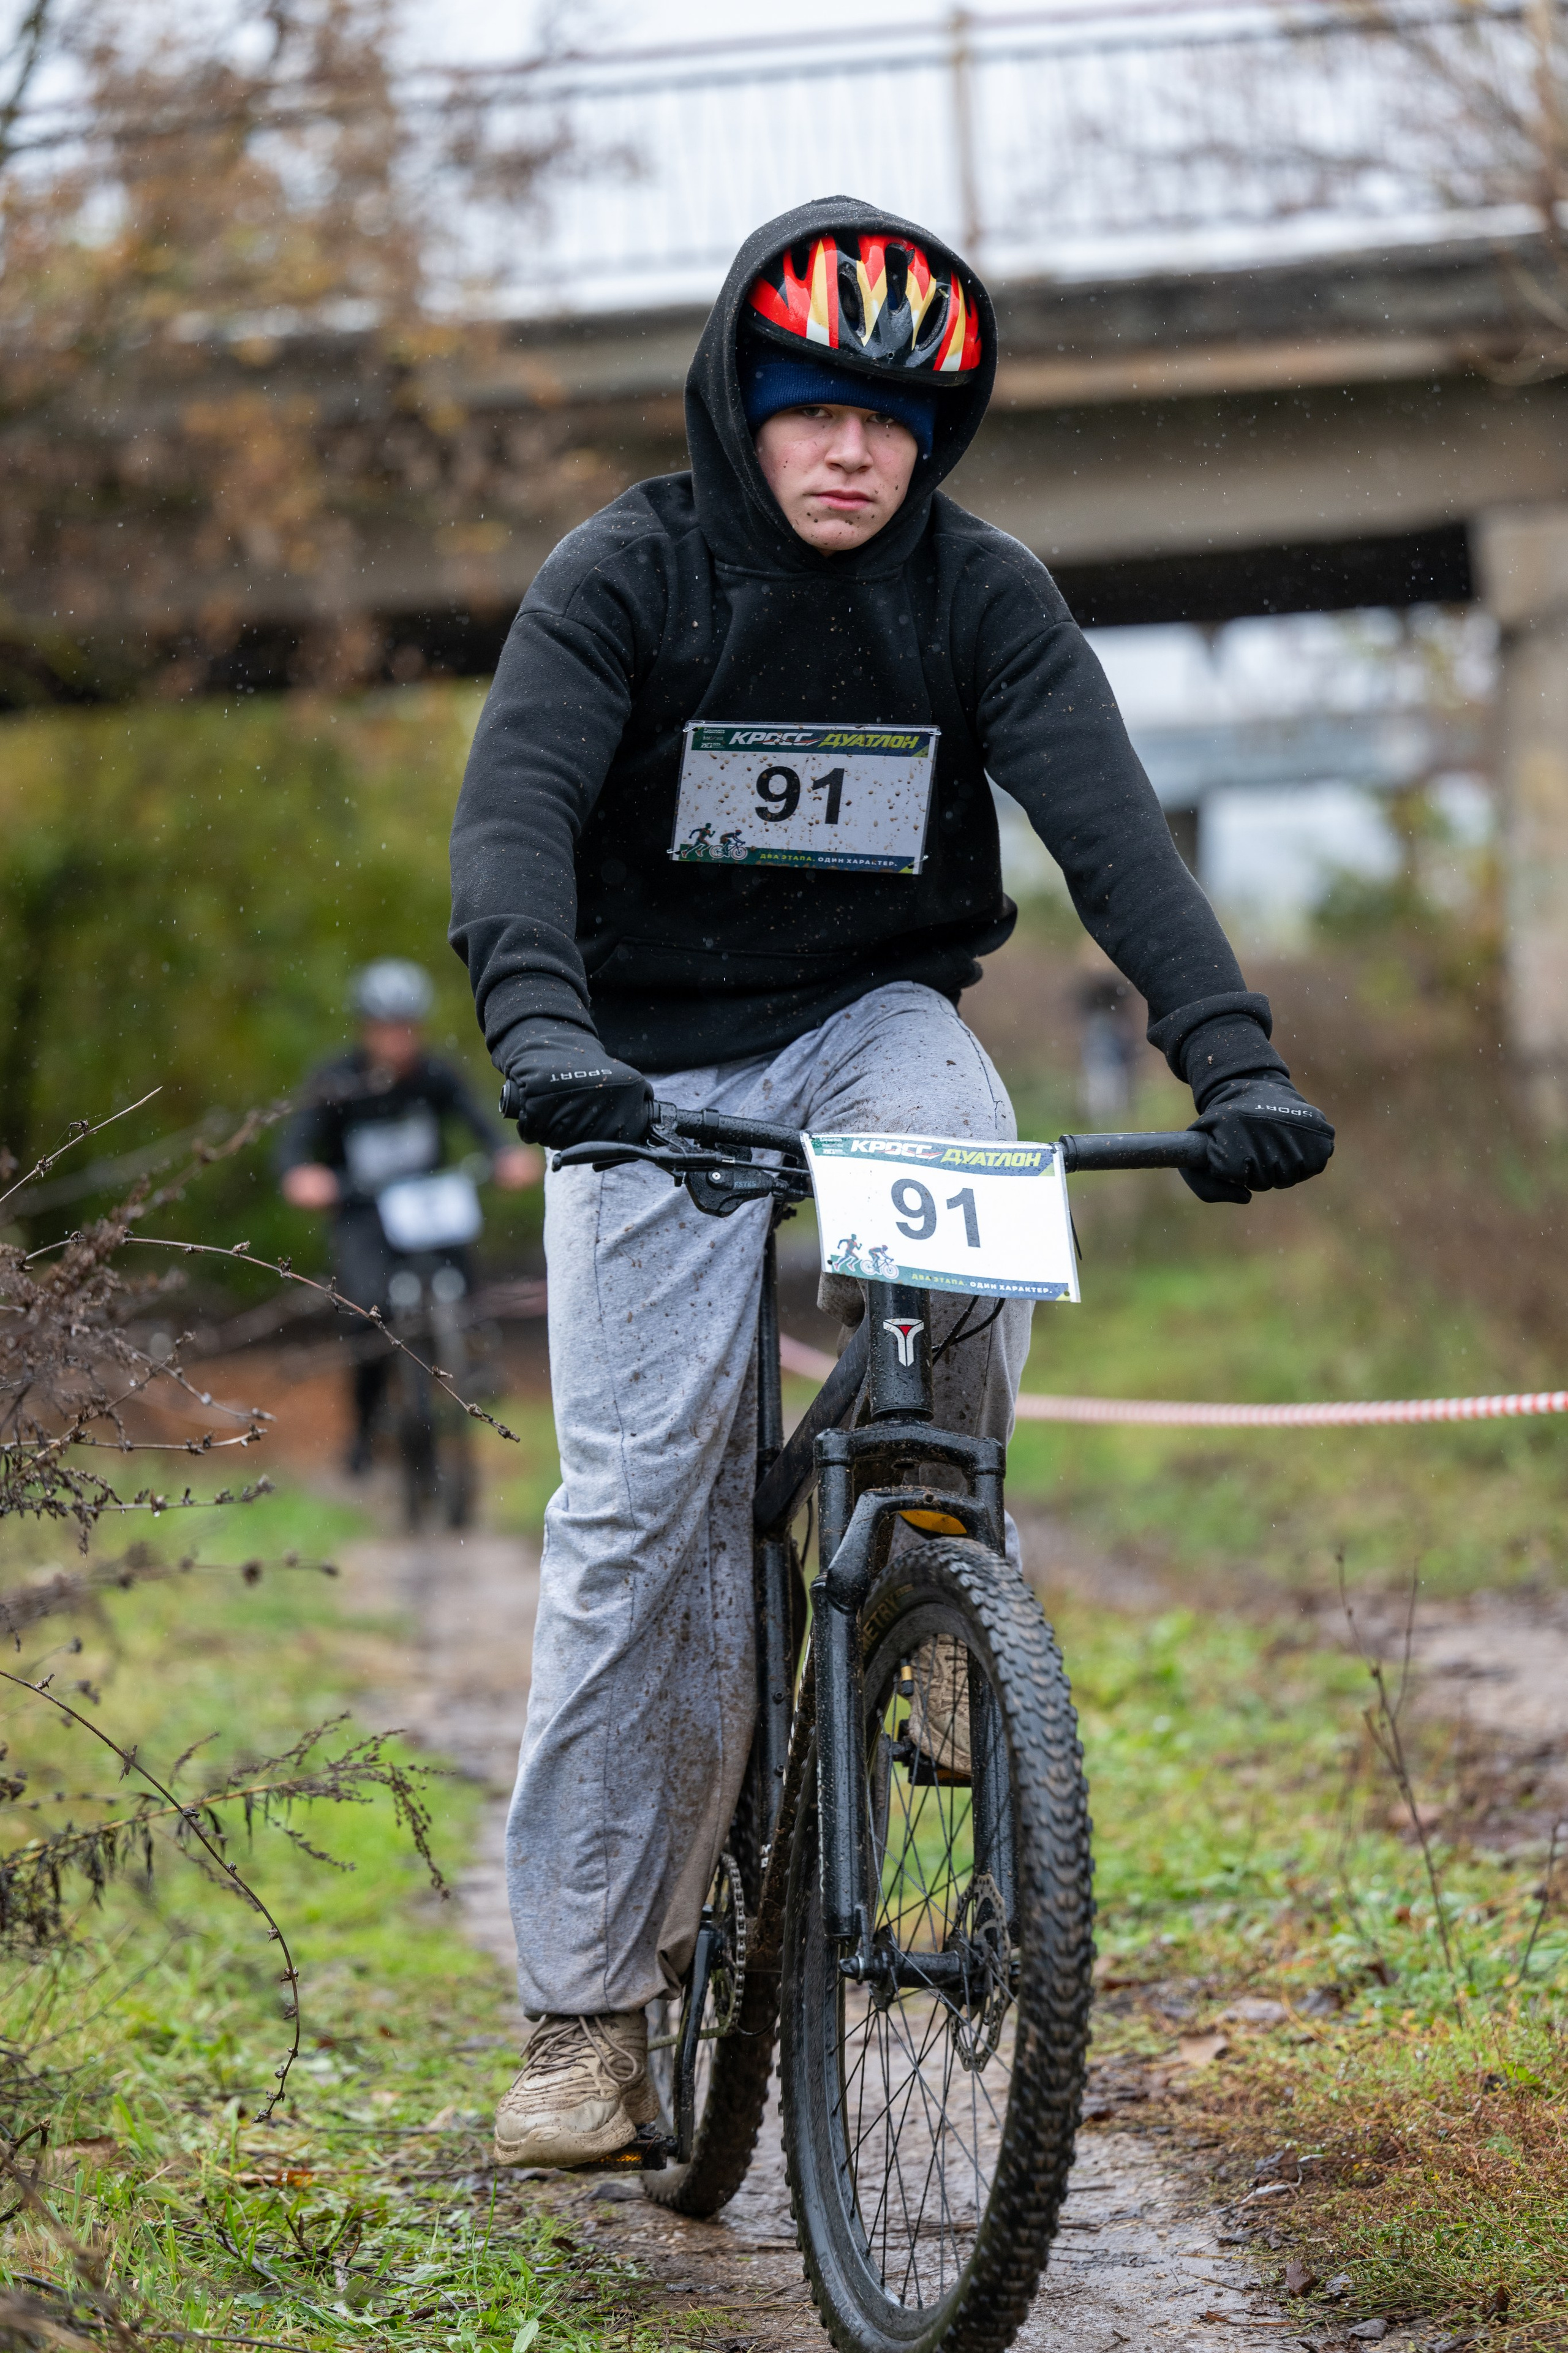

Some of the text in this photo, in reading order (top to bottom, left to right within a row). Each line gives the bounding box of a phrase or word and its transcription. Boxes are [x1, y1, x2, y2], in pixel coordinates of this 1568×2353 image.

[729, 731, 821, 746] КРОСС
[818, 733, 919, 749] ДУАТЛОН
[755, 766, 845, 825] 91
[550, 1069, 612, 1082] SPORT
[1254, 1105, 1313, 1117] SPORT
[850, 1140, 1041, 1167] КРОСС ДУАТЛОН
[891, 1178, 981, 1248] 91
[933, 1277, 967, 1286] ЭТАПА.
[970, 1281, 997, 1290] ОДИН
[999, 1285, 1052, 1294] ХАРАКТЕР.
